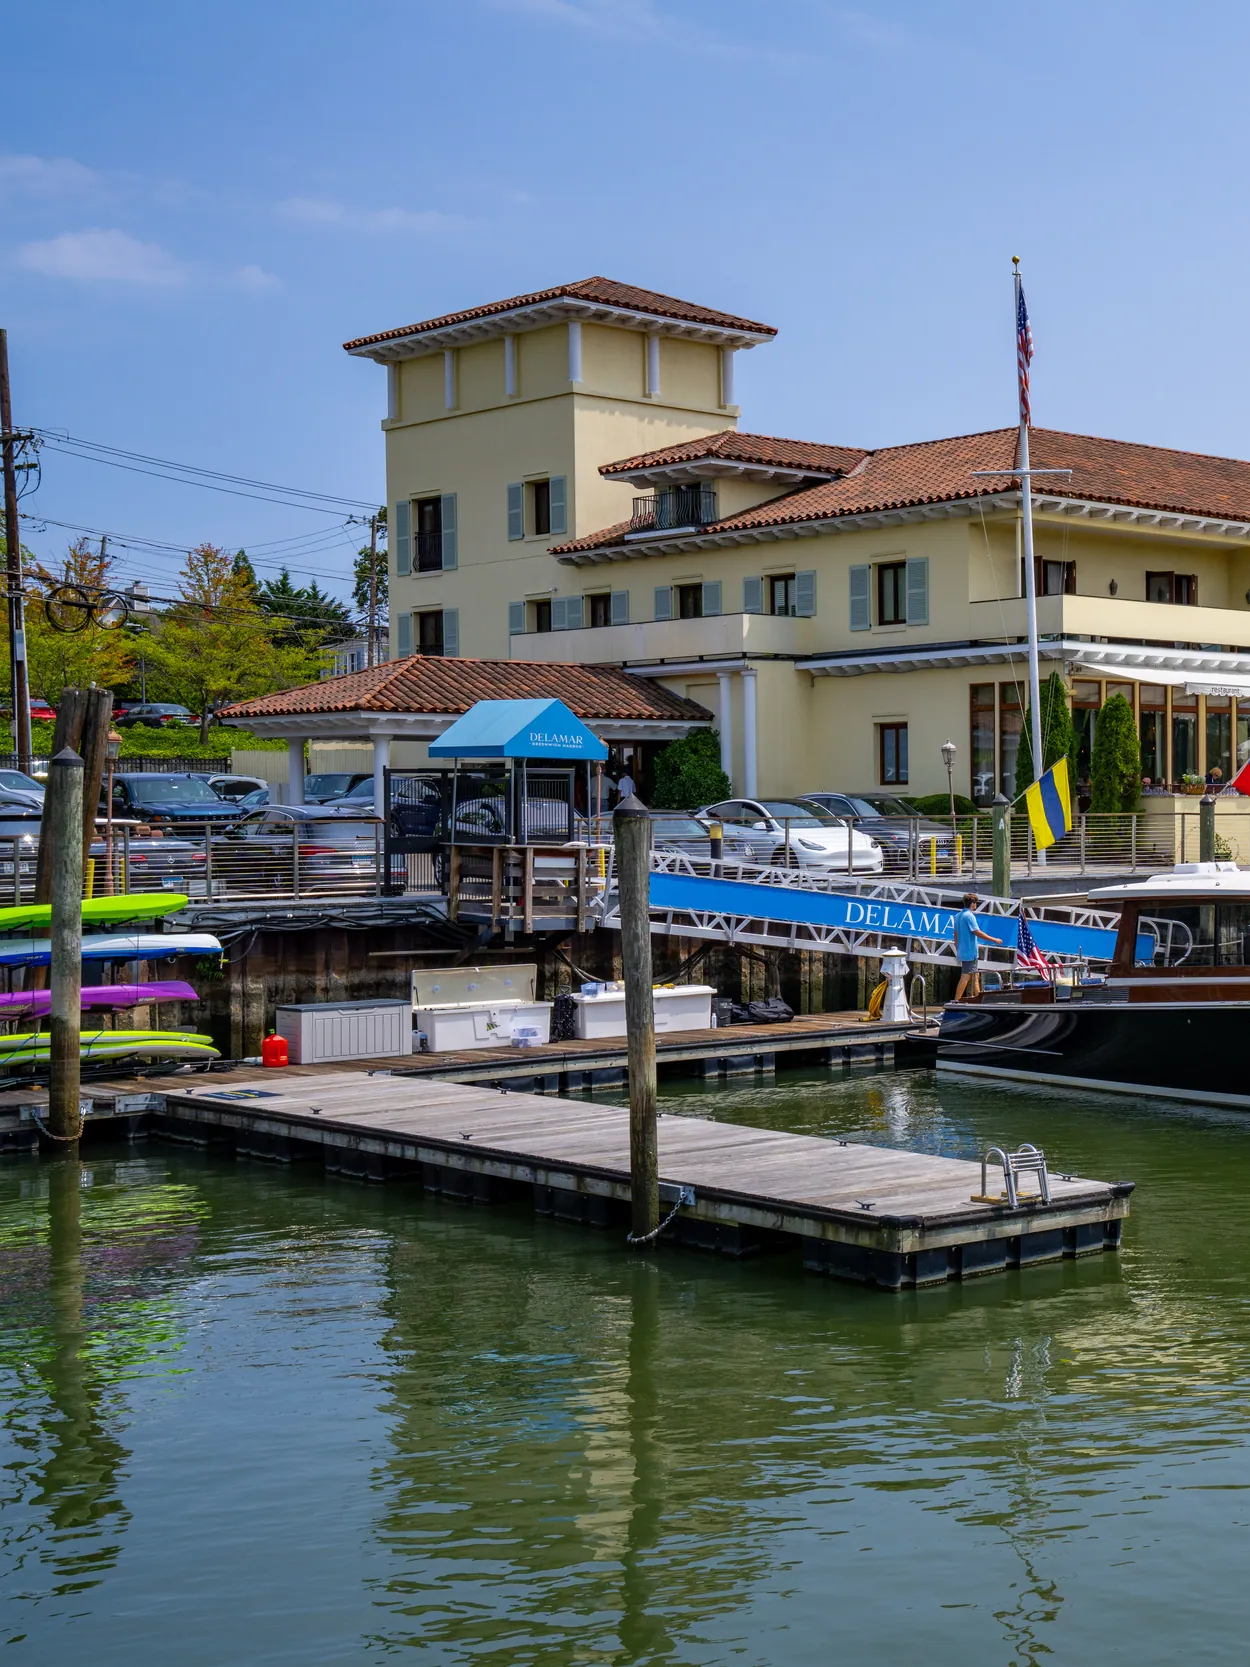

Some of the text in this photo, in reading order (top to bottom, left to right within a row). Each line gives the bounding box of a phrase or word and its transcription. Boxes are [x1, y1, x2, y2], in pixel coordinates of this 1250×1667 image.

[529, 732, 583, 744] DELAMAR
[998, 818, 1005, 830] A
[844, 901, 955, 936] DELAMA
